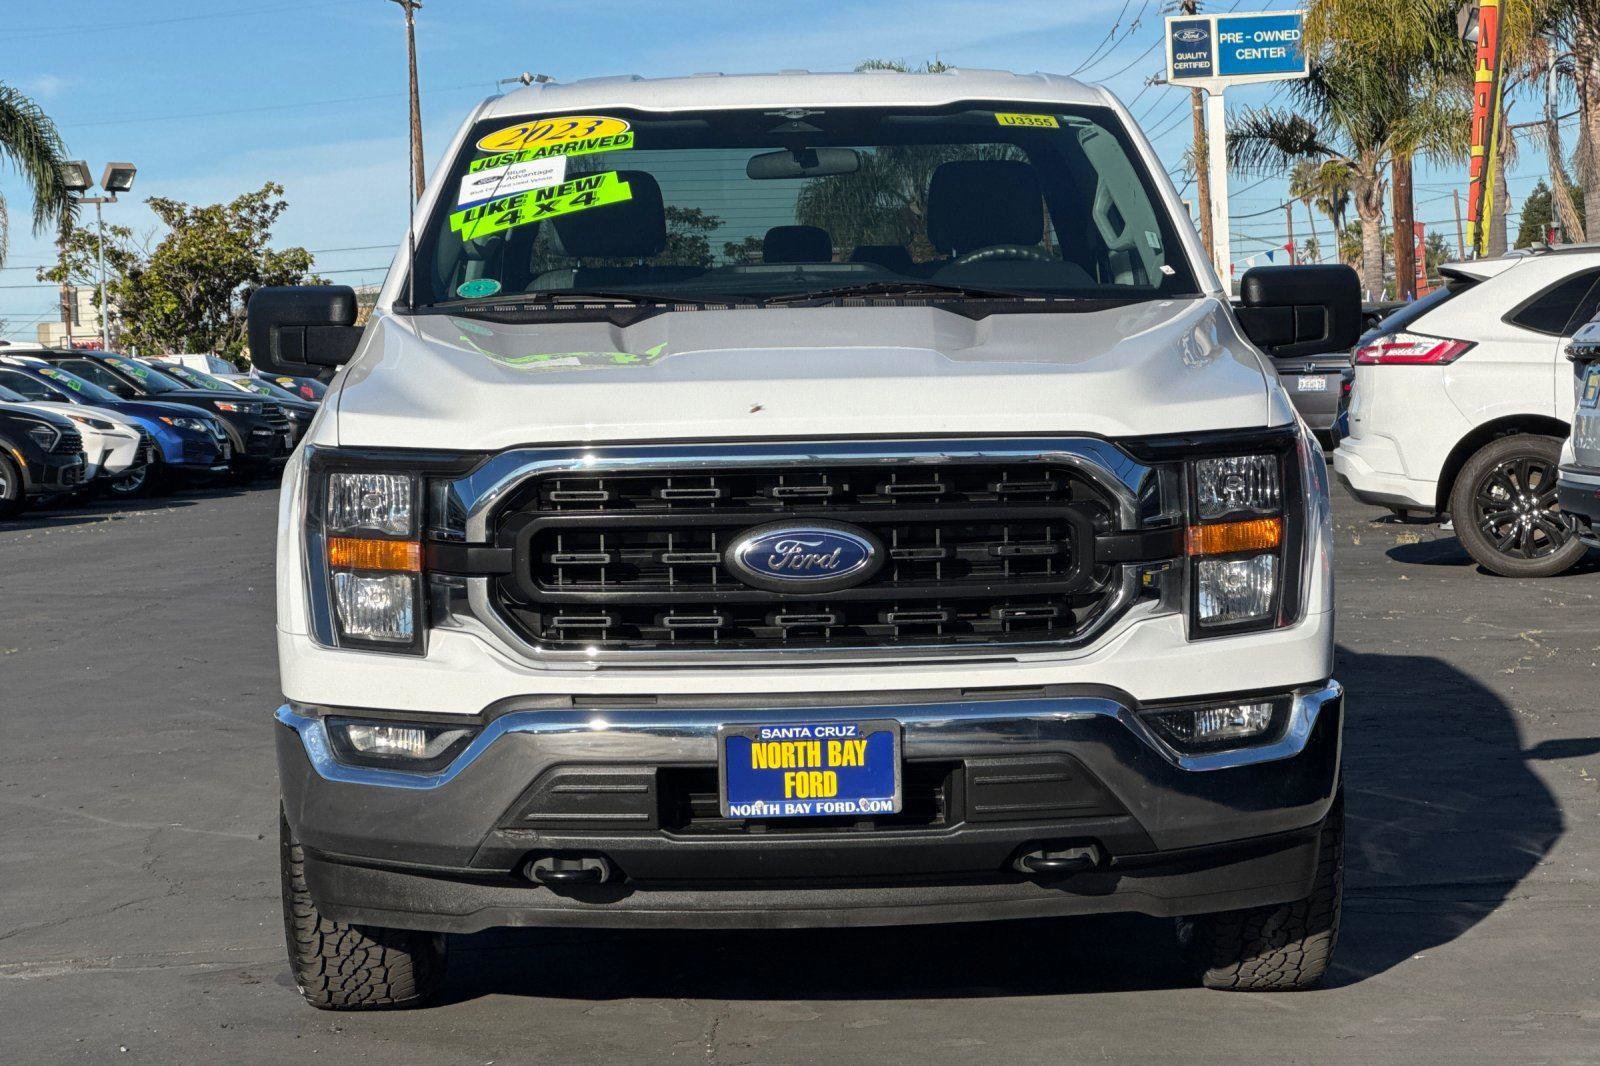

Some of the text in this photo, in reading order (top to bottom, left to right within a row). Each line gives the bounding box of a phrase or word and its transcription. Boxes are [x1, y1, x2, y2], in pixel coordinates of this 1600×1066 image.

[1173, 60, 1211, 70] CERTIFIED
[1176, 51, 1208, 60] QUALITY
[1235, 47, 1286, 60] CENTER
[501, 119, 604, 146] 2023
[473, 134, 630, 172] JUST ARRIVED
[506, 168, 554, 180] Advantage
[462, 175, 607, 224] LIKE NEW
[495, 209, 525, 226] 4
[569, 191, 600, 206] 4
[767, 539, 842, 570] Ford
[761, 726, 856, 739] SANTA CRUZ
[751, 740, 868, 770] NORTH BAY
[784, 771, 838, 799] FORD
[730, 804, 780, 816] NORTH
[785, 803, 811, 815] BAY
